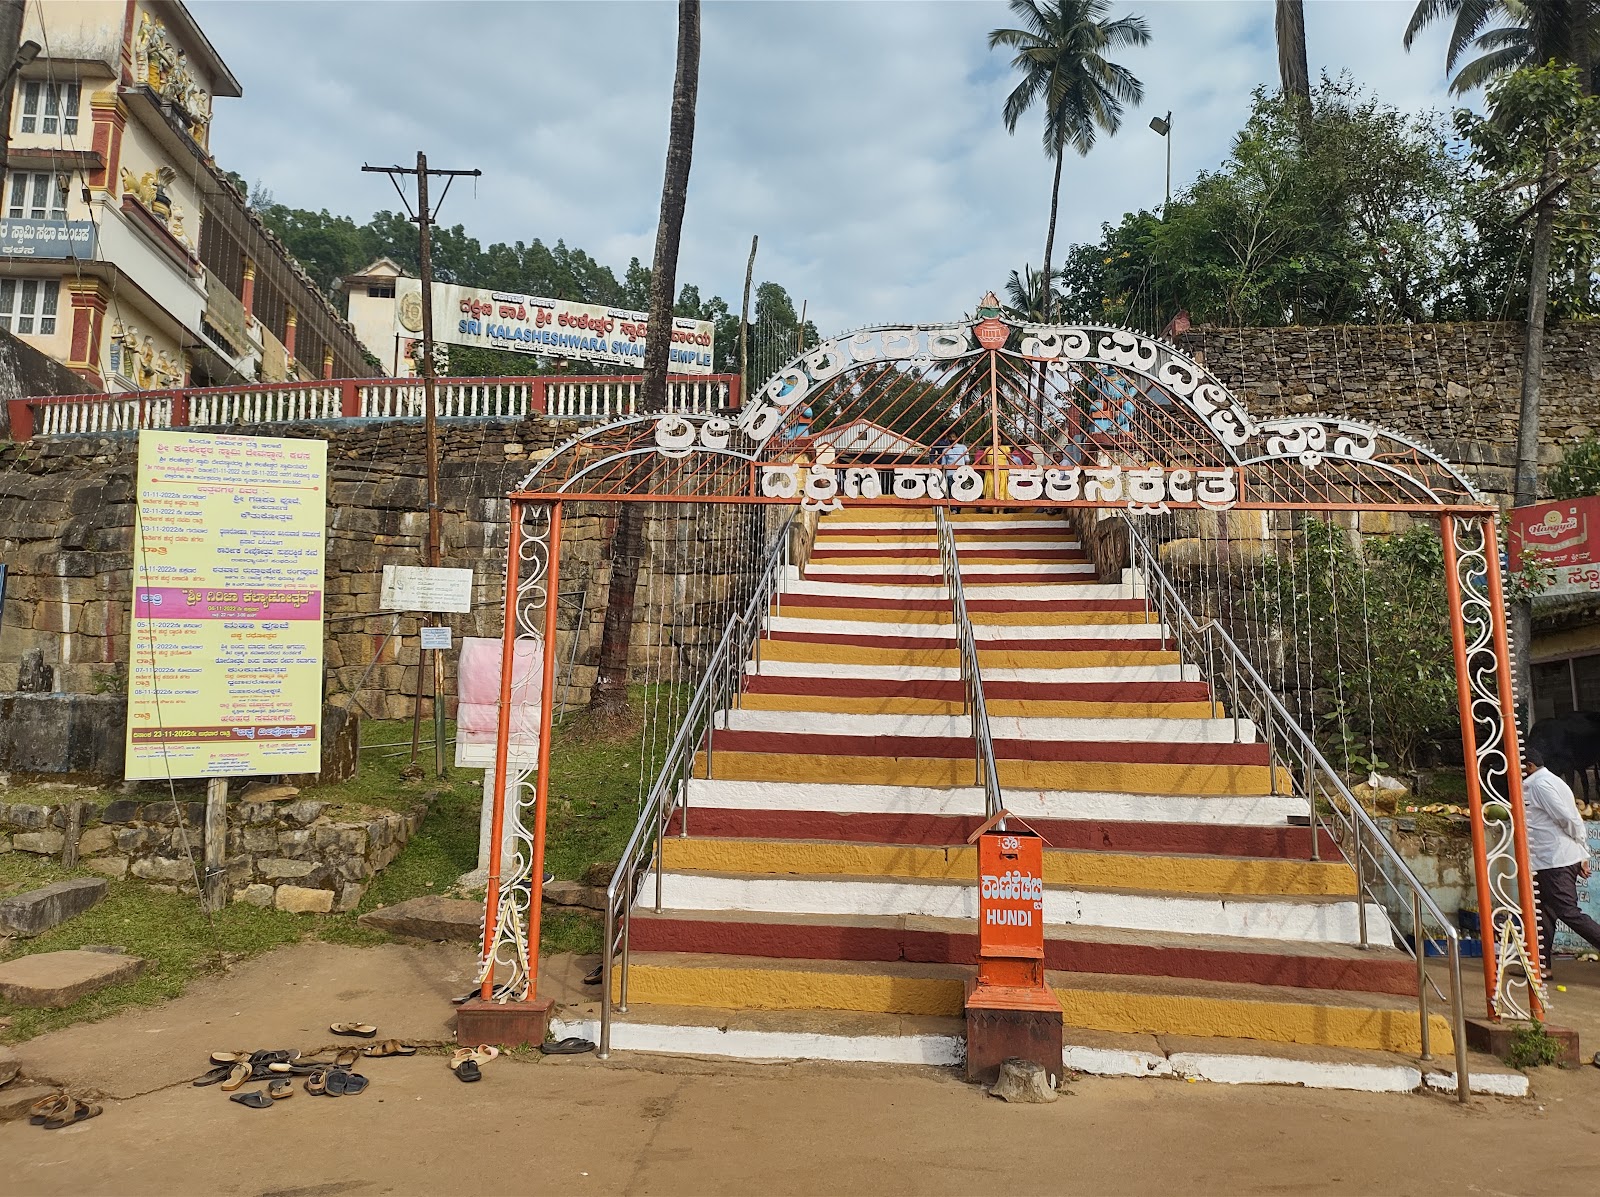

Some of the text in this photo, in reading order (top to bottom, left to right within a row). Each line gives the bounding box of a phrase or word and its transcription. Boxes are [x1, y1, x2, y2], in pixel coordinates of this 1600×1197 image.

[535, 307, 552, 328] ಶ್ರೀ
[459, 319, 481, 336] SRI
[486, 323, 607, 352] KALASHESHWARA
[670, 348, 711, 366] EMPLE
[655, 414, 731, 459] ಶ್ರೀ
[1021, 327, 1158, 373] ಸ್ವಾಮಿ
[762, 464, 881, 512] ದಕ್ಷಿಣ
[893, 464, 984, 503] ಕಾಶಿ
[986, 909, 1032, 927] HUNDI
